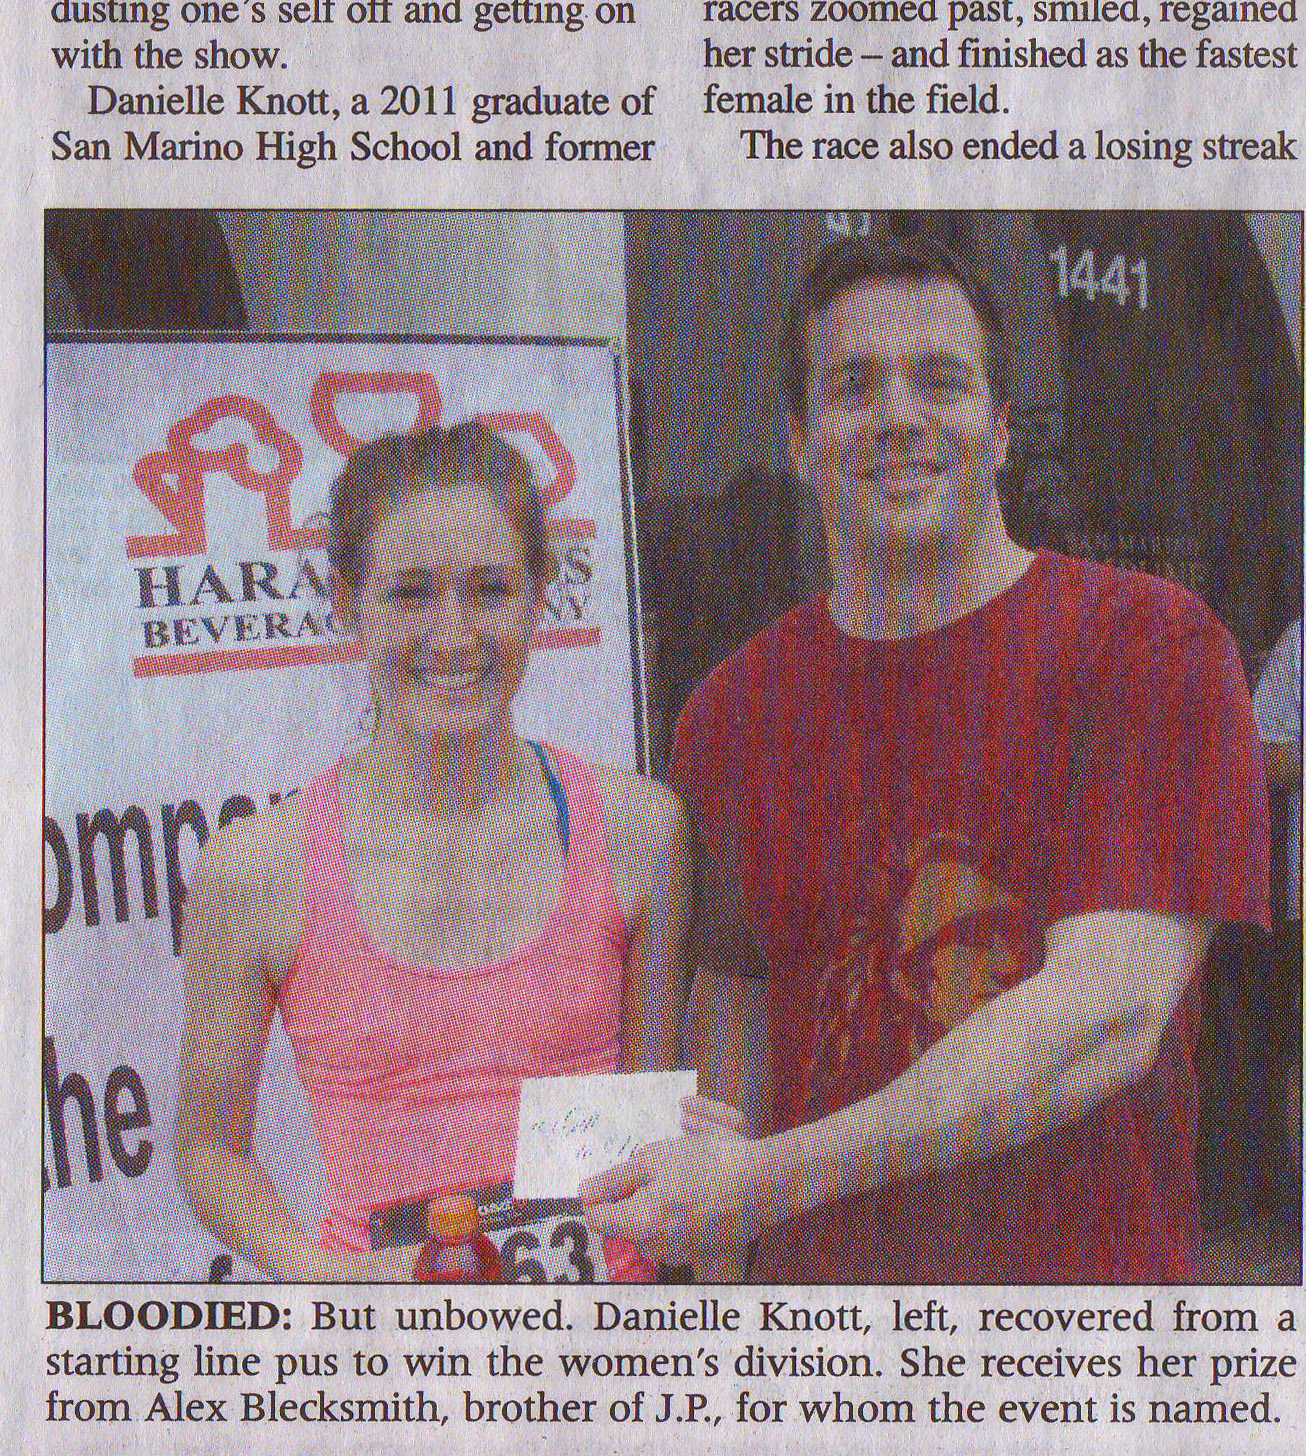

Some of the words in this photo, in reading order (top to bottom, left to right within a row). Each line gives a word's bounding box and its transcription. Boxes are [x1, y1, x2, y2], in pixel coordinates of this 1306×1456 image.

[87, 84, 225, 116] Danielle
[236, 84, 341, 121] Knott,
[350, 93, 370, 116] a
[380, 84, 456, 116] 2011
[471, 84, 610, 125] graduate
[620, 84, 658, 117] of
[1049, 242, 1149, 310] 1441
[45, 1299, 292, 1331] BLOODIED:
[311, 1300, 377, 1332] But
[394, 1298, 574, 1332] unbowed.
[593, 1298, 741, 1332] Danielle
[759, 1301, 872, 1336] Knott,
[892, 1298, 958, 1336] left,
[978, 1299, 1155, 1333] recovered
[1172, 1299, 1259, 1333] from
[1277, 1309, 1297, 1333] a
